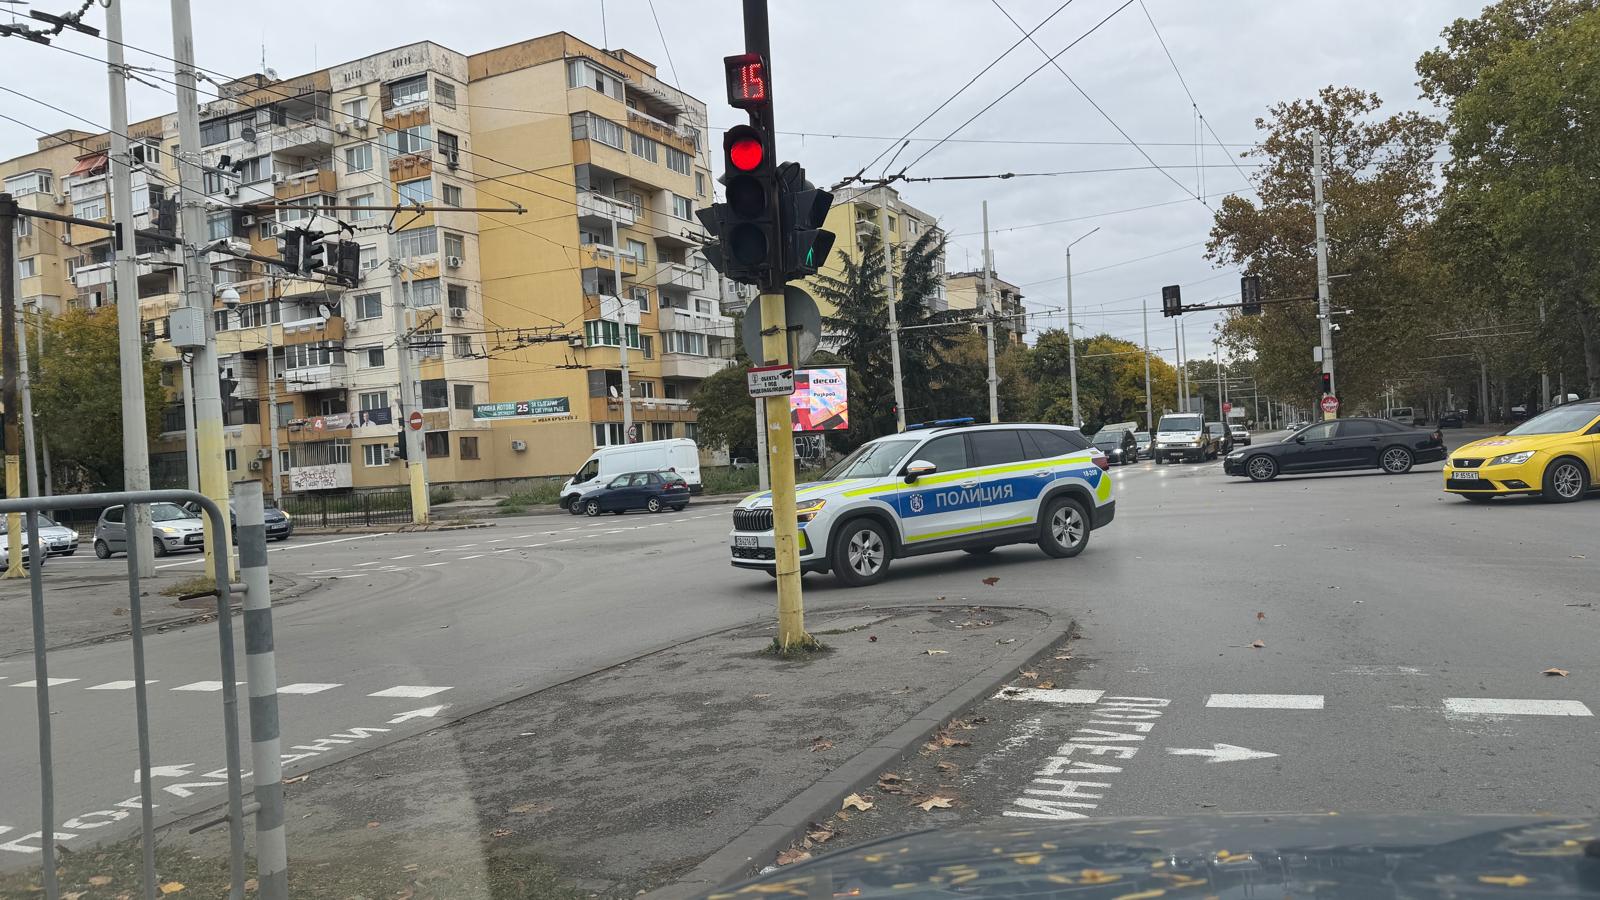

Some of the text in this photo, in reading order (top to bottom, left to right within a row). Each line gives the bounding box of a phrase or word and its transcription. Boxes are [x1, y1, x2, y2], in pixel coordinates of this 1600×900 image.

[742, 63, 764, 99] 15
[516, 404, 529, 413] 25
[936, 484, 1013, 507] ПОЛИЦИЯ
[1002, 696, 1172, 820] ПОГЛЕДНИ
